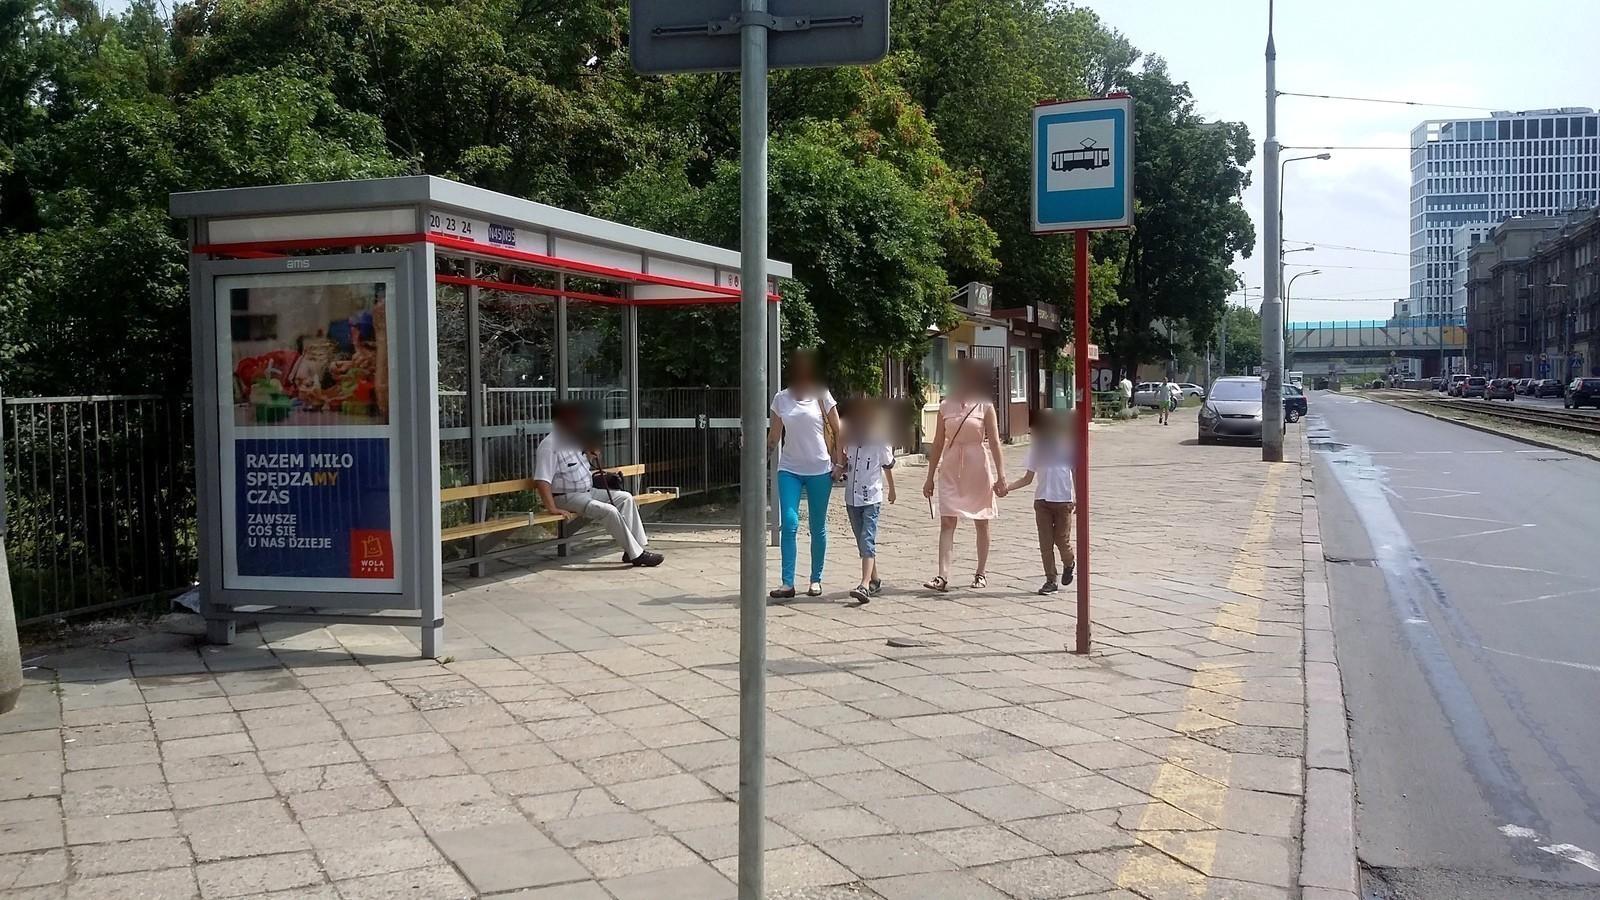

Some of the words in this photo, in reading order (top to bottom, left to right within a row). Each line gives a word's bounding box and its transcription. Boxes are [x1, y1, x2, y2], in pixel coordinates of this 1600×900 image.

[430, 214, 440, 228] 20
[446, 218, 456, 231] 23
[462, 221, 472, 234] 24
[287, 259, 310, 269] ams
[246, 453, 304, 468] RAZEM
[310, 453, 354, 468] MIŁO
[246, 471, 338, 489] SPĘDZAMY
[247, 490, 290, 504] CZAS
[247, 513, 297, 524] ZAWSZE
[247, 522, 273, 536] COŚ
[276, 525, 297, 539] SIĘ
[248, 537, 257, 548] U
[260, 537, 286, 548] NAS
[289, 537, 332, 548] DZIEJE
